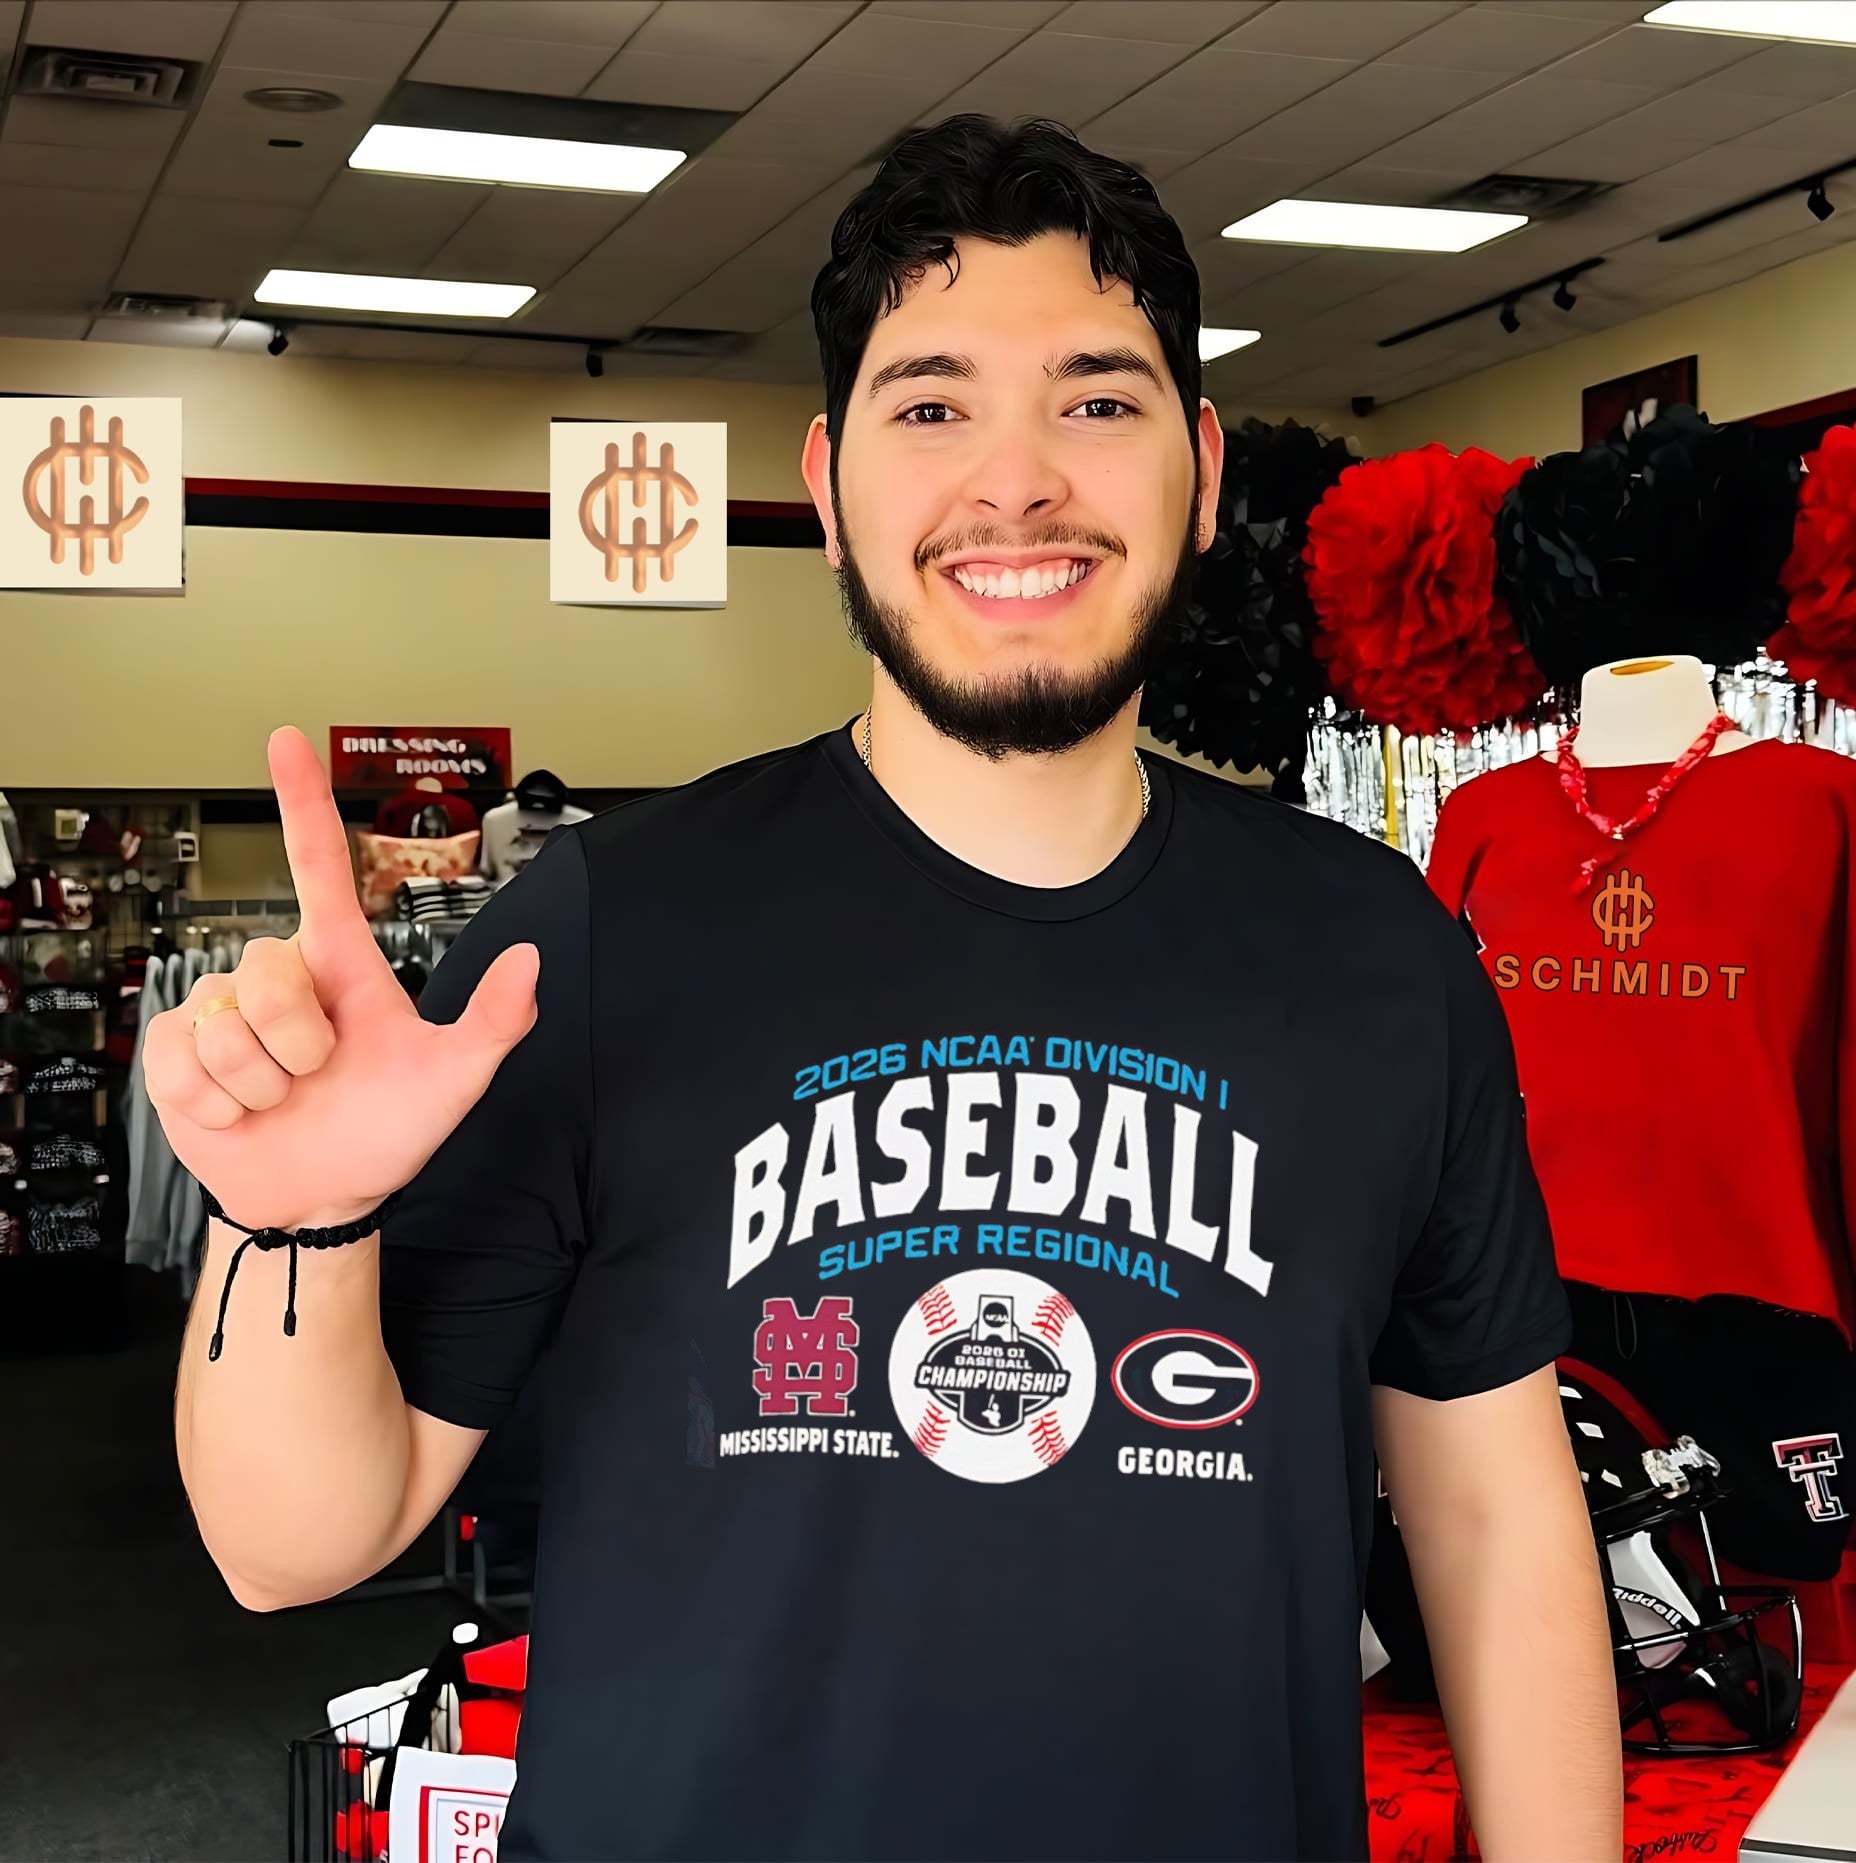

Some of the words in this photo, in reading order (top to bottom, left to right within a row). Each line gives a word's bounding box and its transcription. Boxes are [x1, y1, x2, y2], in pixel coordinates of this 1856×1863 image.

[342, 737, 467, 754] DRESSING
[396, 758, 487, 775] ROOMS
[1494, 953, 1748, 1001] SCHMIDT
[793, 1043, 908, 1101] 2026
[1045, 1037, 1207, 1101] DIVISION
[726, 1071, 1275, 1298] BASEBALL
[818, 1224, 960, 1280] SUPER
[977, 1224, 1180, 1298] REGIONAL
[917, 1365, 1067, 1394] CHAMPIONSHIP
[719, 1427, 829, 1458] MISSISSIPPI
